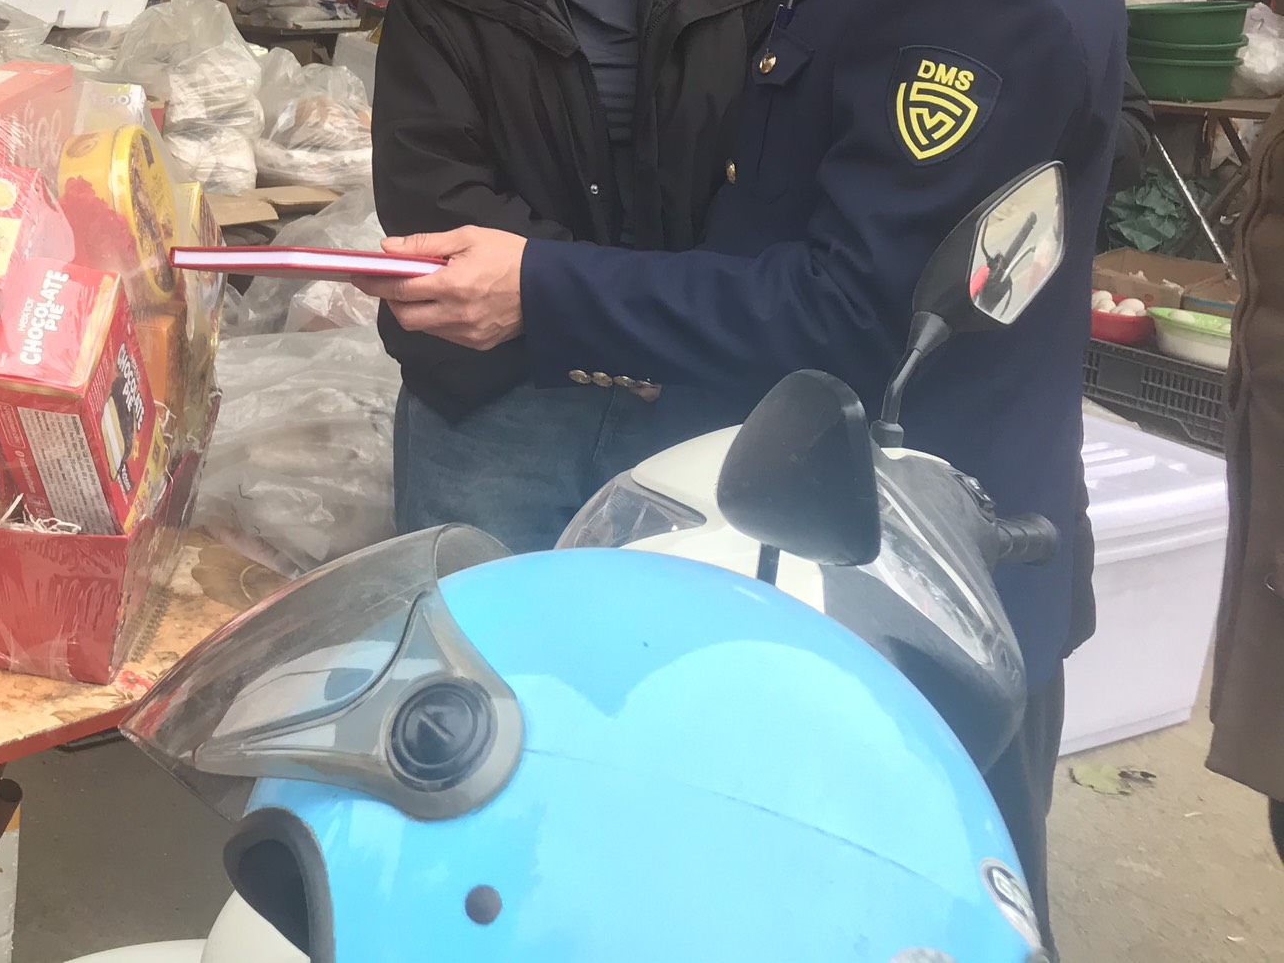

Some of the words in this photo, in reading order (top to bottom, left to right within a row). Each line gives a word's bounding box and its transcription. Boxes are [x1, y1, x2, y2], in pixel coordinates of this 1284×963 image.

[917, 59, 975, 91] DMS
[19, 269, 70, 366] CHOCOLATE
[44, 303, 66, 333] PIE
[116, 341, 146, 431] CHOCOLATE
